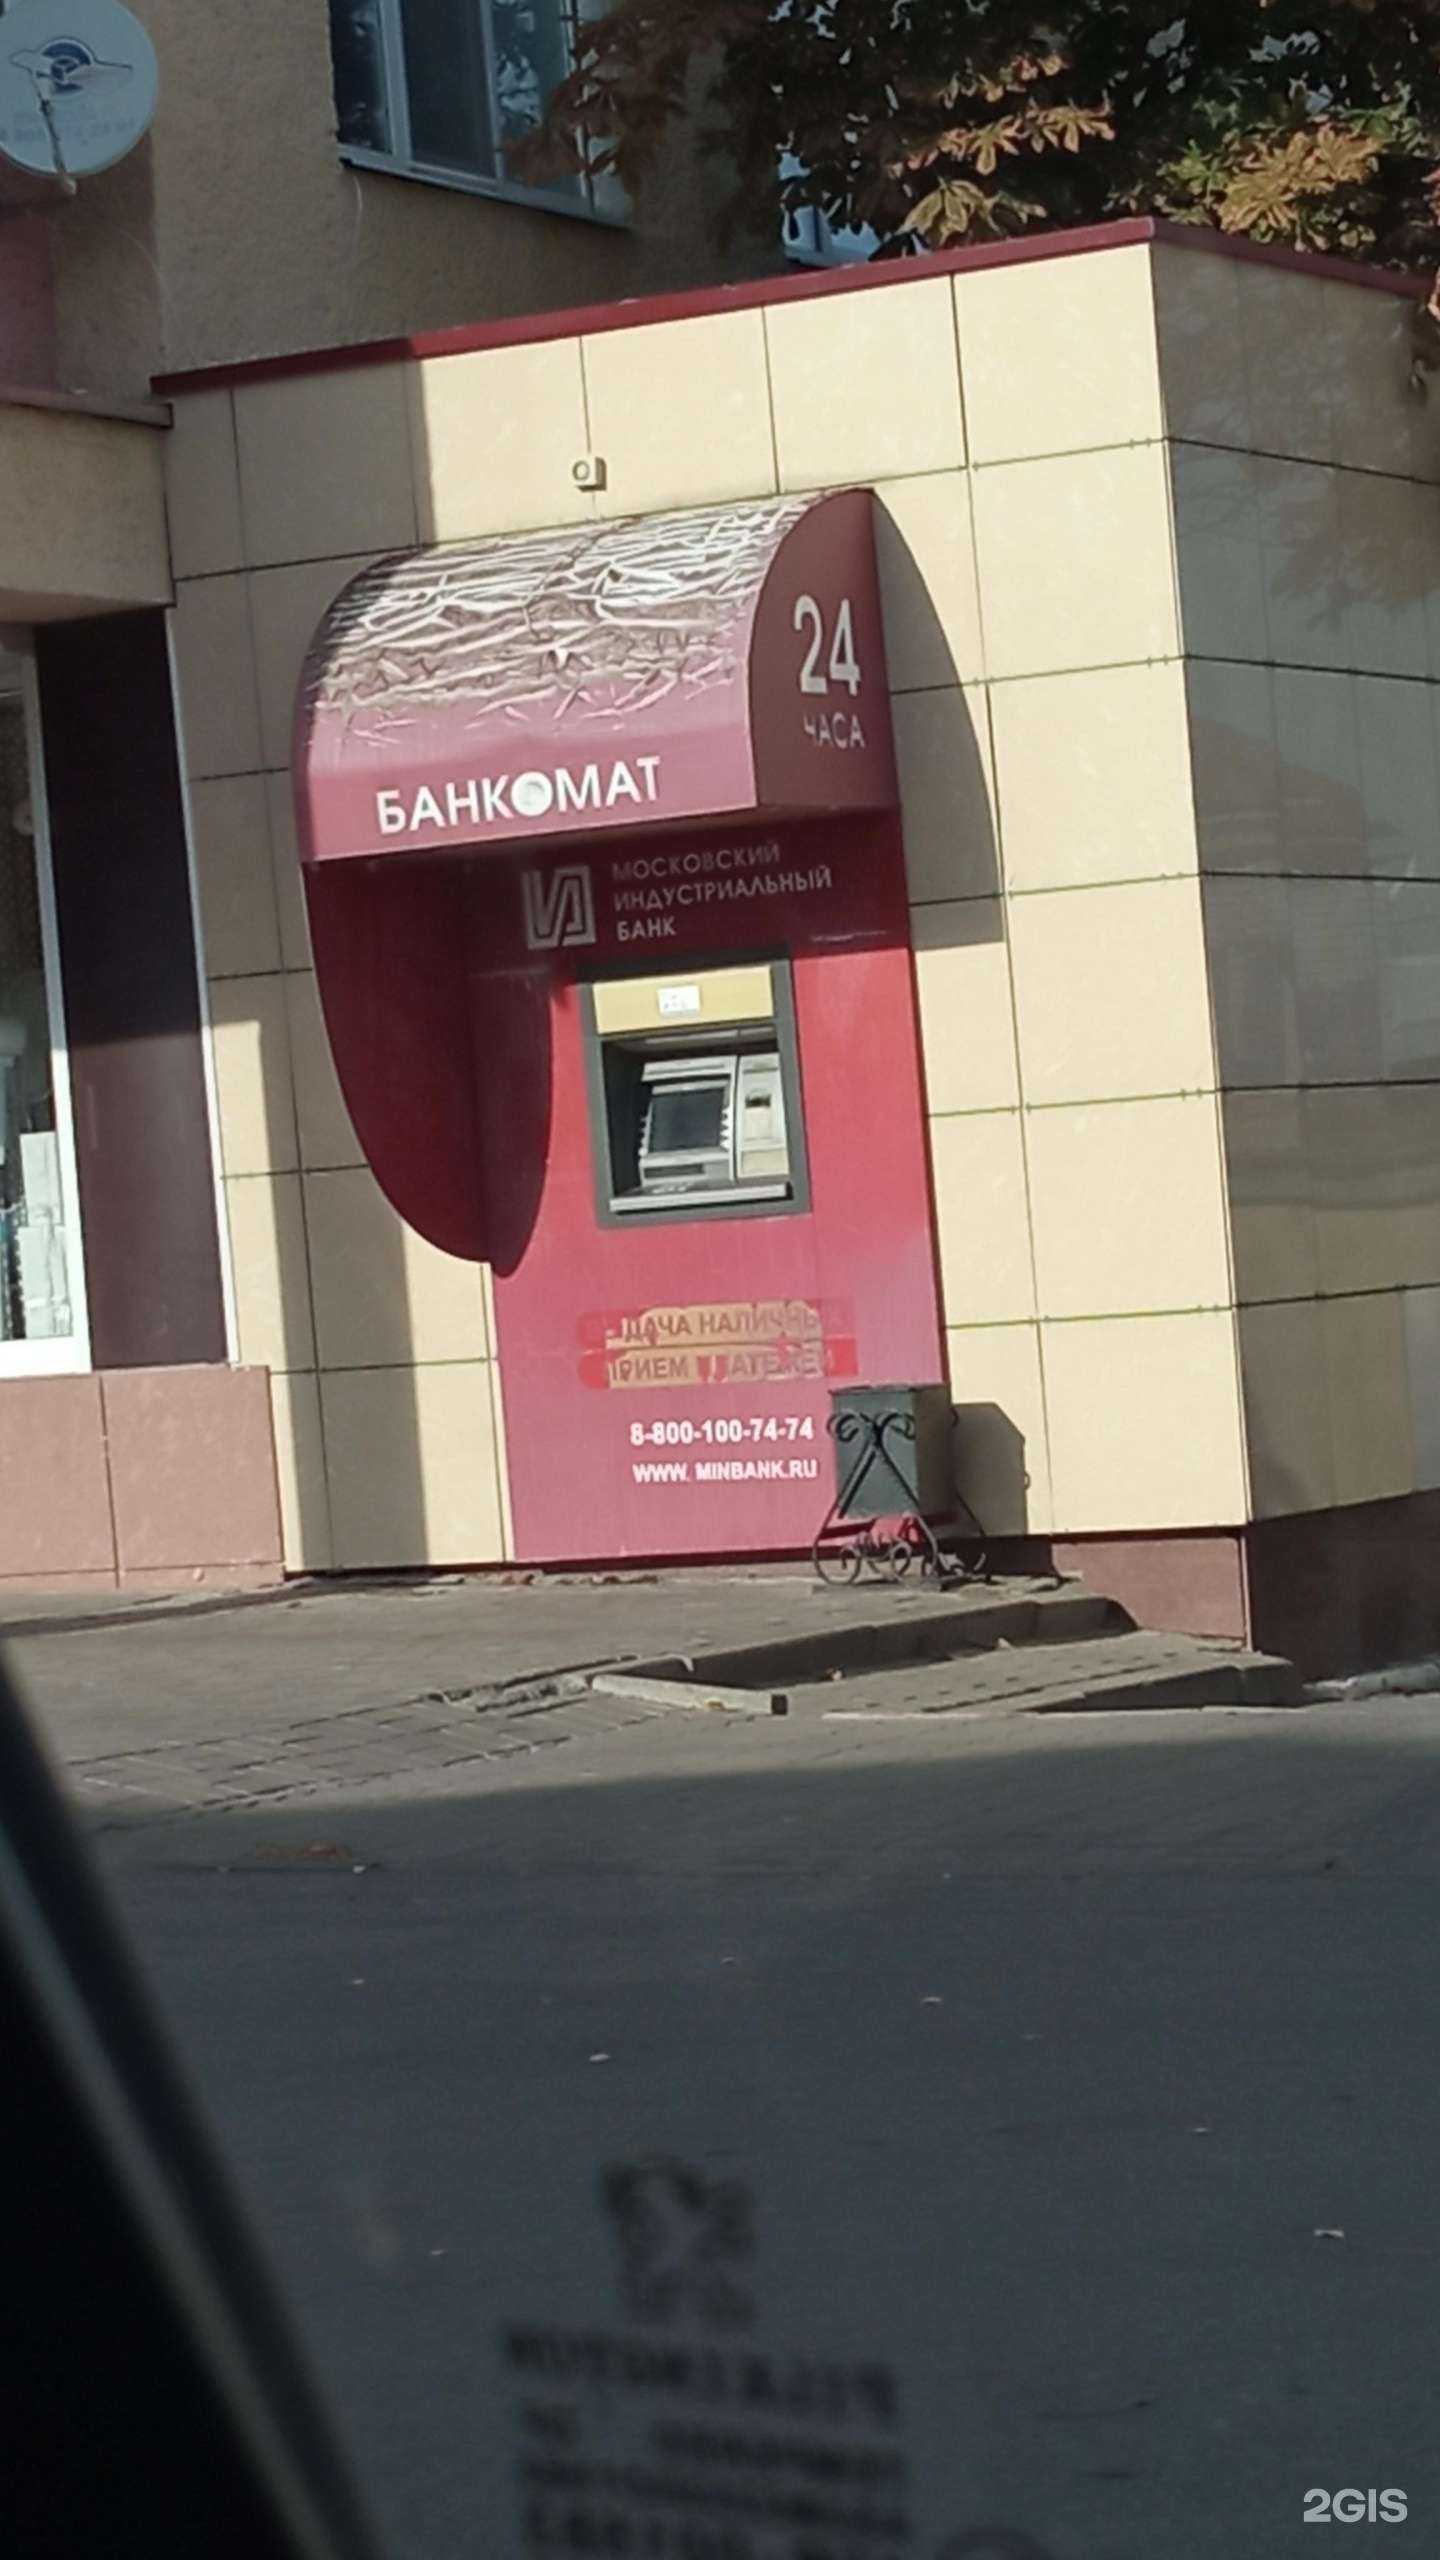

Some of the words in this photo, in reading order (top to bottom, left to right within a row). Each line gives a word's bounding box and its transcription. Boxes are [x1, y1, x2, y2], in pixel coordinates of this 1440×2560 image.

[793, 594, 861, 696] 24
[803, 711, 866, 749] ЧАСА
[375, 756, 662, 835] БАНКОМАТ
[611, 843, 780, 881] МОСКОВСКИЙ
[613, 865, 833, 912] ИНДУСТРИАЛЬНЫЙ
[616, 916, 677, 942] БАНК
[622, 1315, 692, 1345] ДАЧА
[630, 1416, 814, 1446] 8-800-100-74-74
